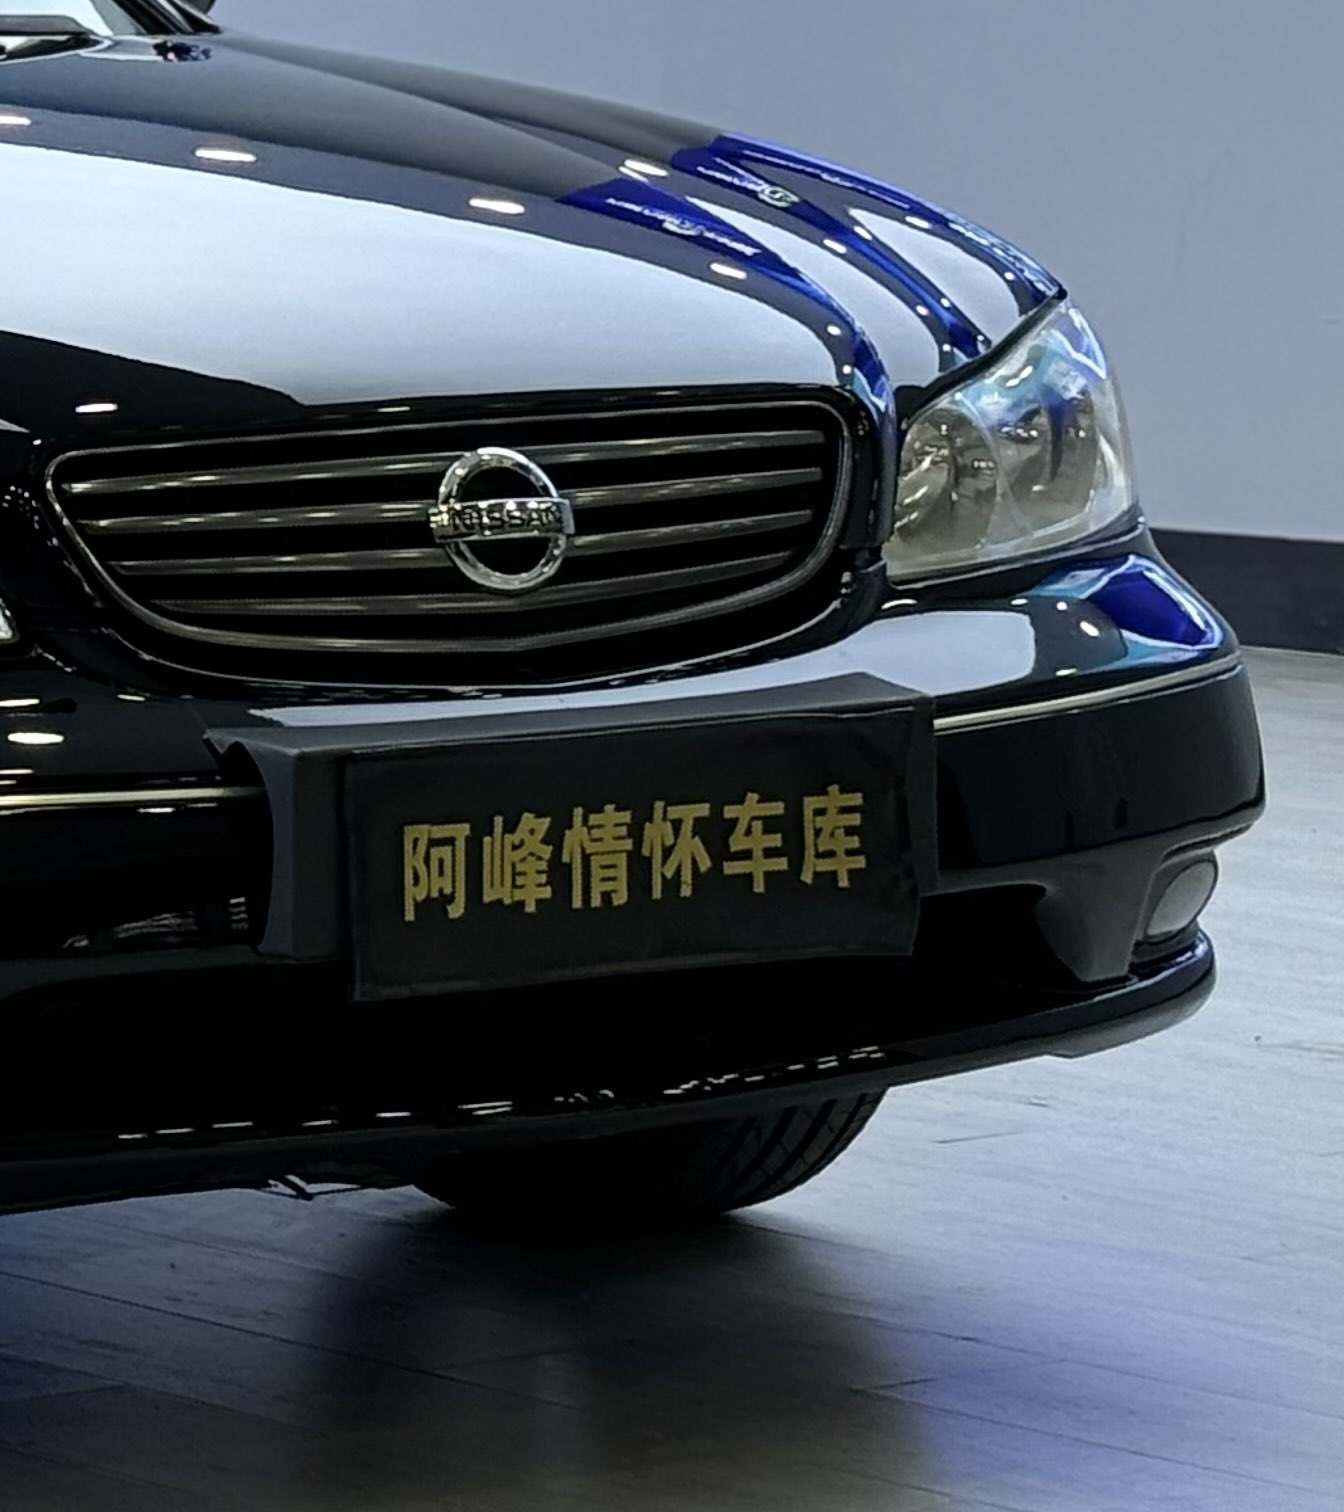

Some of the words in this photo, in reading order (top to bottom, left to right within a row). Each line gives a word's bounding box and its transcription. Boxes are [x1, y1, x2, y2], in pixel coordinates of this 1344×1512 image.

[402, 784, 868, 922] 阿峰情怀车库
